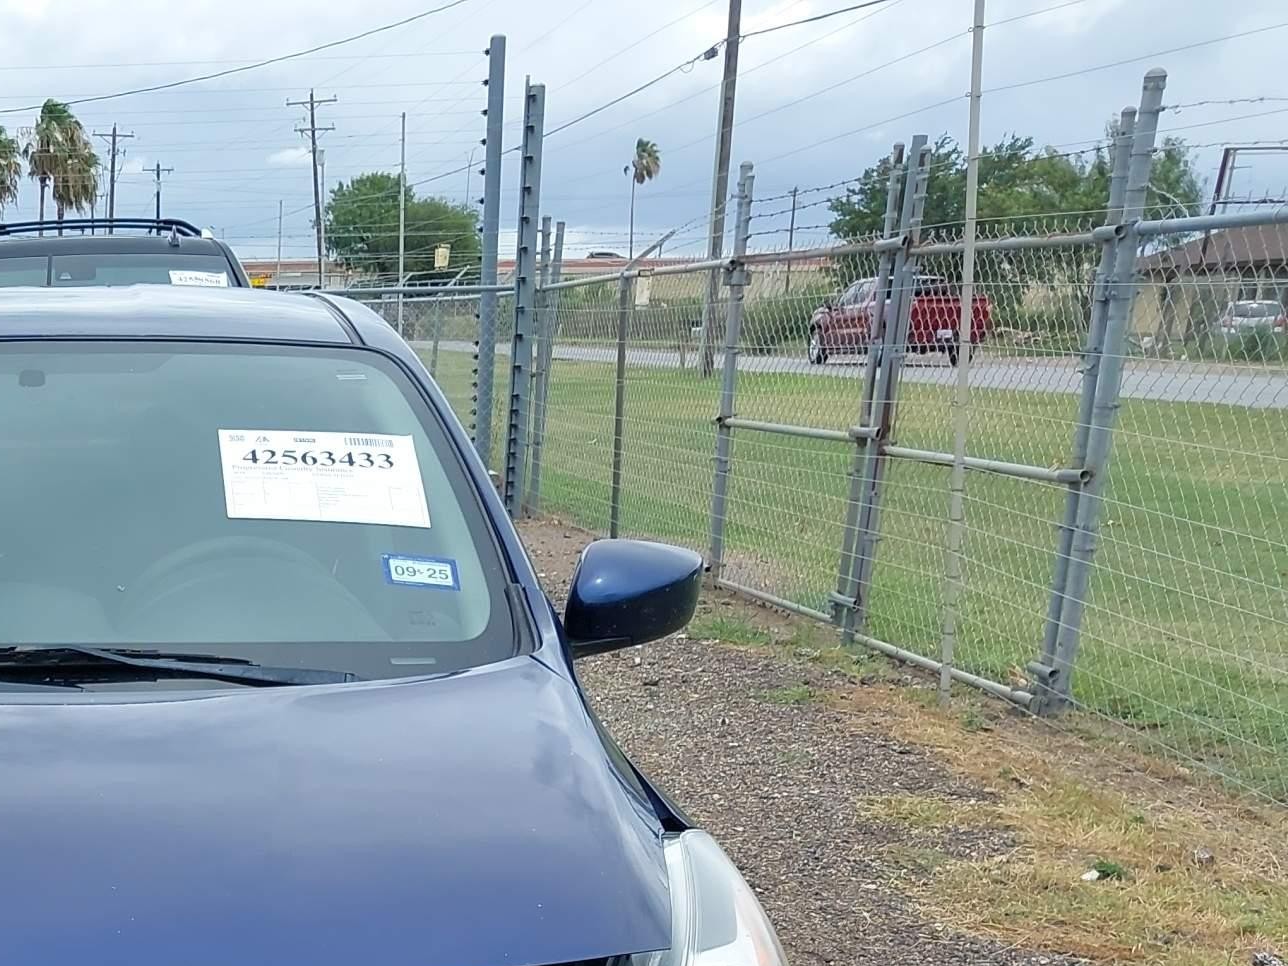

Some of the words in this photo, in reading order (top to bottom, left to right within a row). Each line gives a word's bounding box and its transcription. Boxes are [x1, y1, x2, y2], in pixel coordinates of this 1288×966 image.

[242, 449, 395, 469] 42563433
[394, 565, 417, 577] 09
[426, 567, 449, 580] 25
